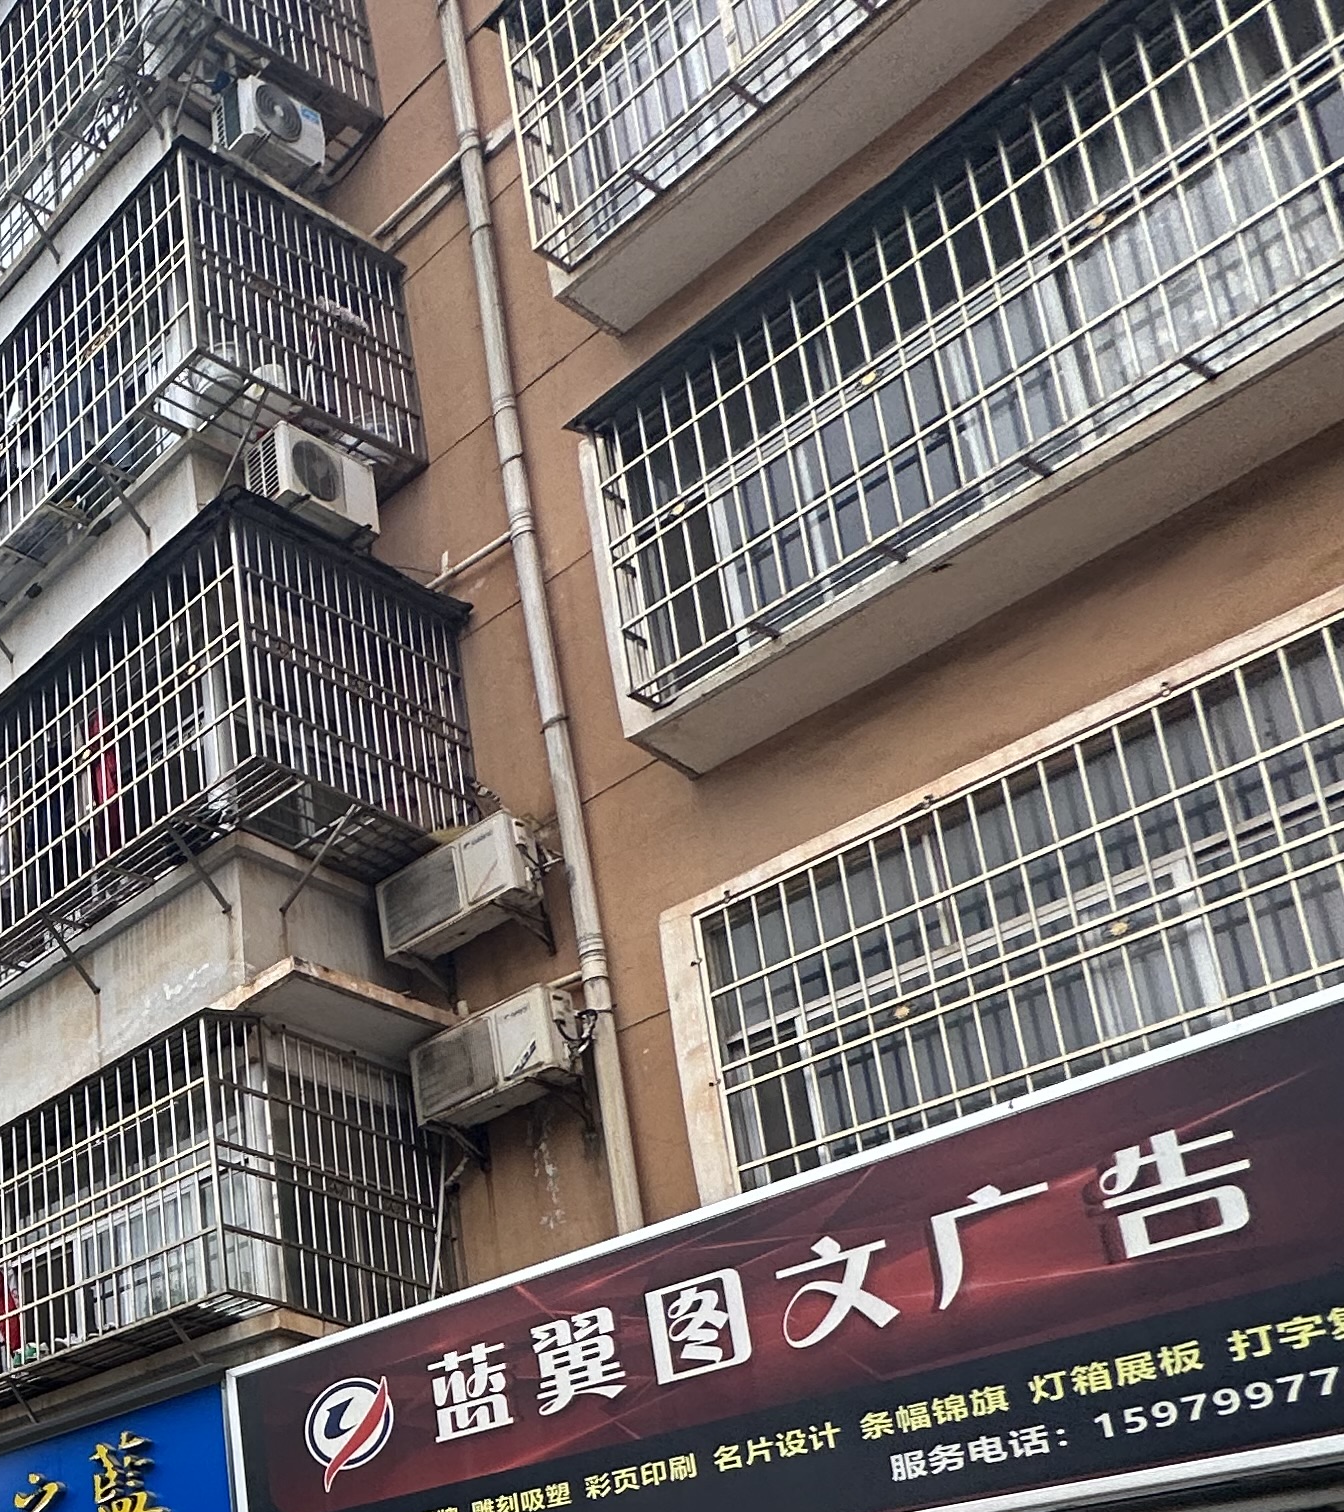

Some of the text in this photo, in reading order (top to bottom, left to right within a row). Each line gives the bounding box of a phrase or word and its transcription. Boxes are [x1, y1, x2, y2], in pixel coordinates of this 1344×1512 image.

[427, 1128, 1251, 1444] 蓝翼图文广告
[585, 1452, 698, 1500] 彩页印刷
[713, 1421, 841, 1473] 名片设计
[858, 1384, 1010, 1441] 条幅锦旗
[1027, 1339, 1205, 1405] 灯箱展板
[1093, 1366, 1340, 1440] 15979977
